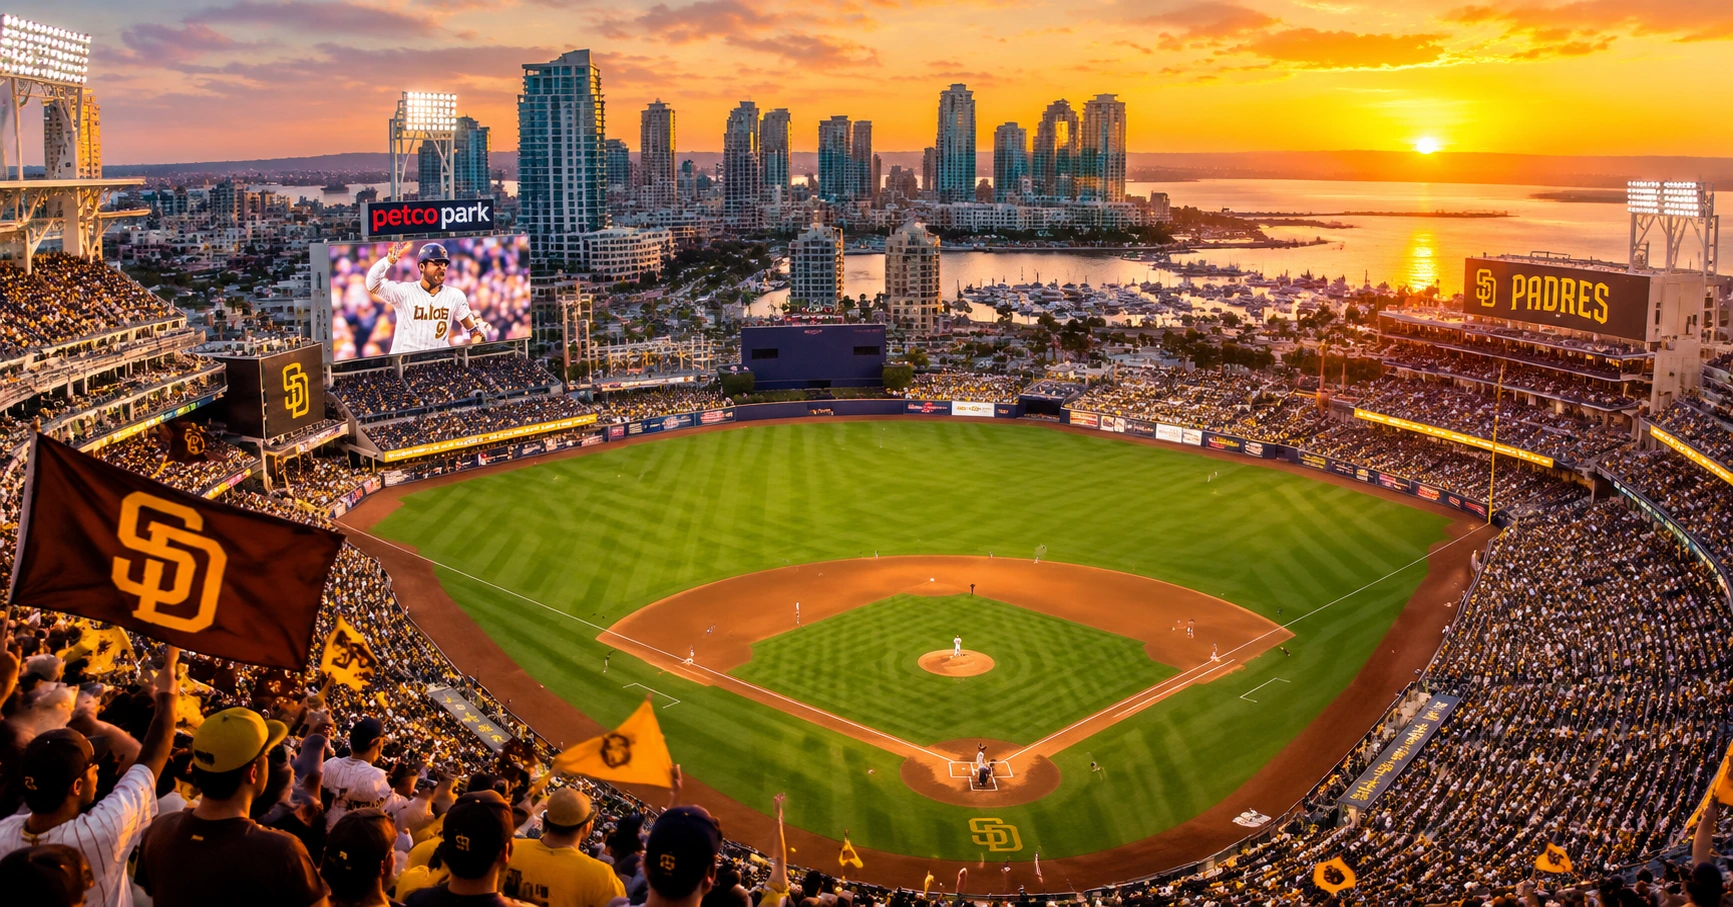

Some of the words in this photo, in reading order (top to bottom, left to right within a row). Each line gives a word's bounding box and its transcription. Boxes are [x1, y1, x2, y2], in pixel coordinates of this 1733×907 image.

[373, 204, 438, 231] petco
[440, 203, 490, 230] park
[1476, 268, 1497, 308] SD
[1511, 274, 1609, 325] PADRES
[282, 362, 310, 419] SD
[111, 490, 228, 632] SD
[968, 817, 1023, 852] SD
